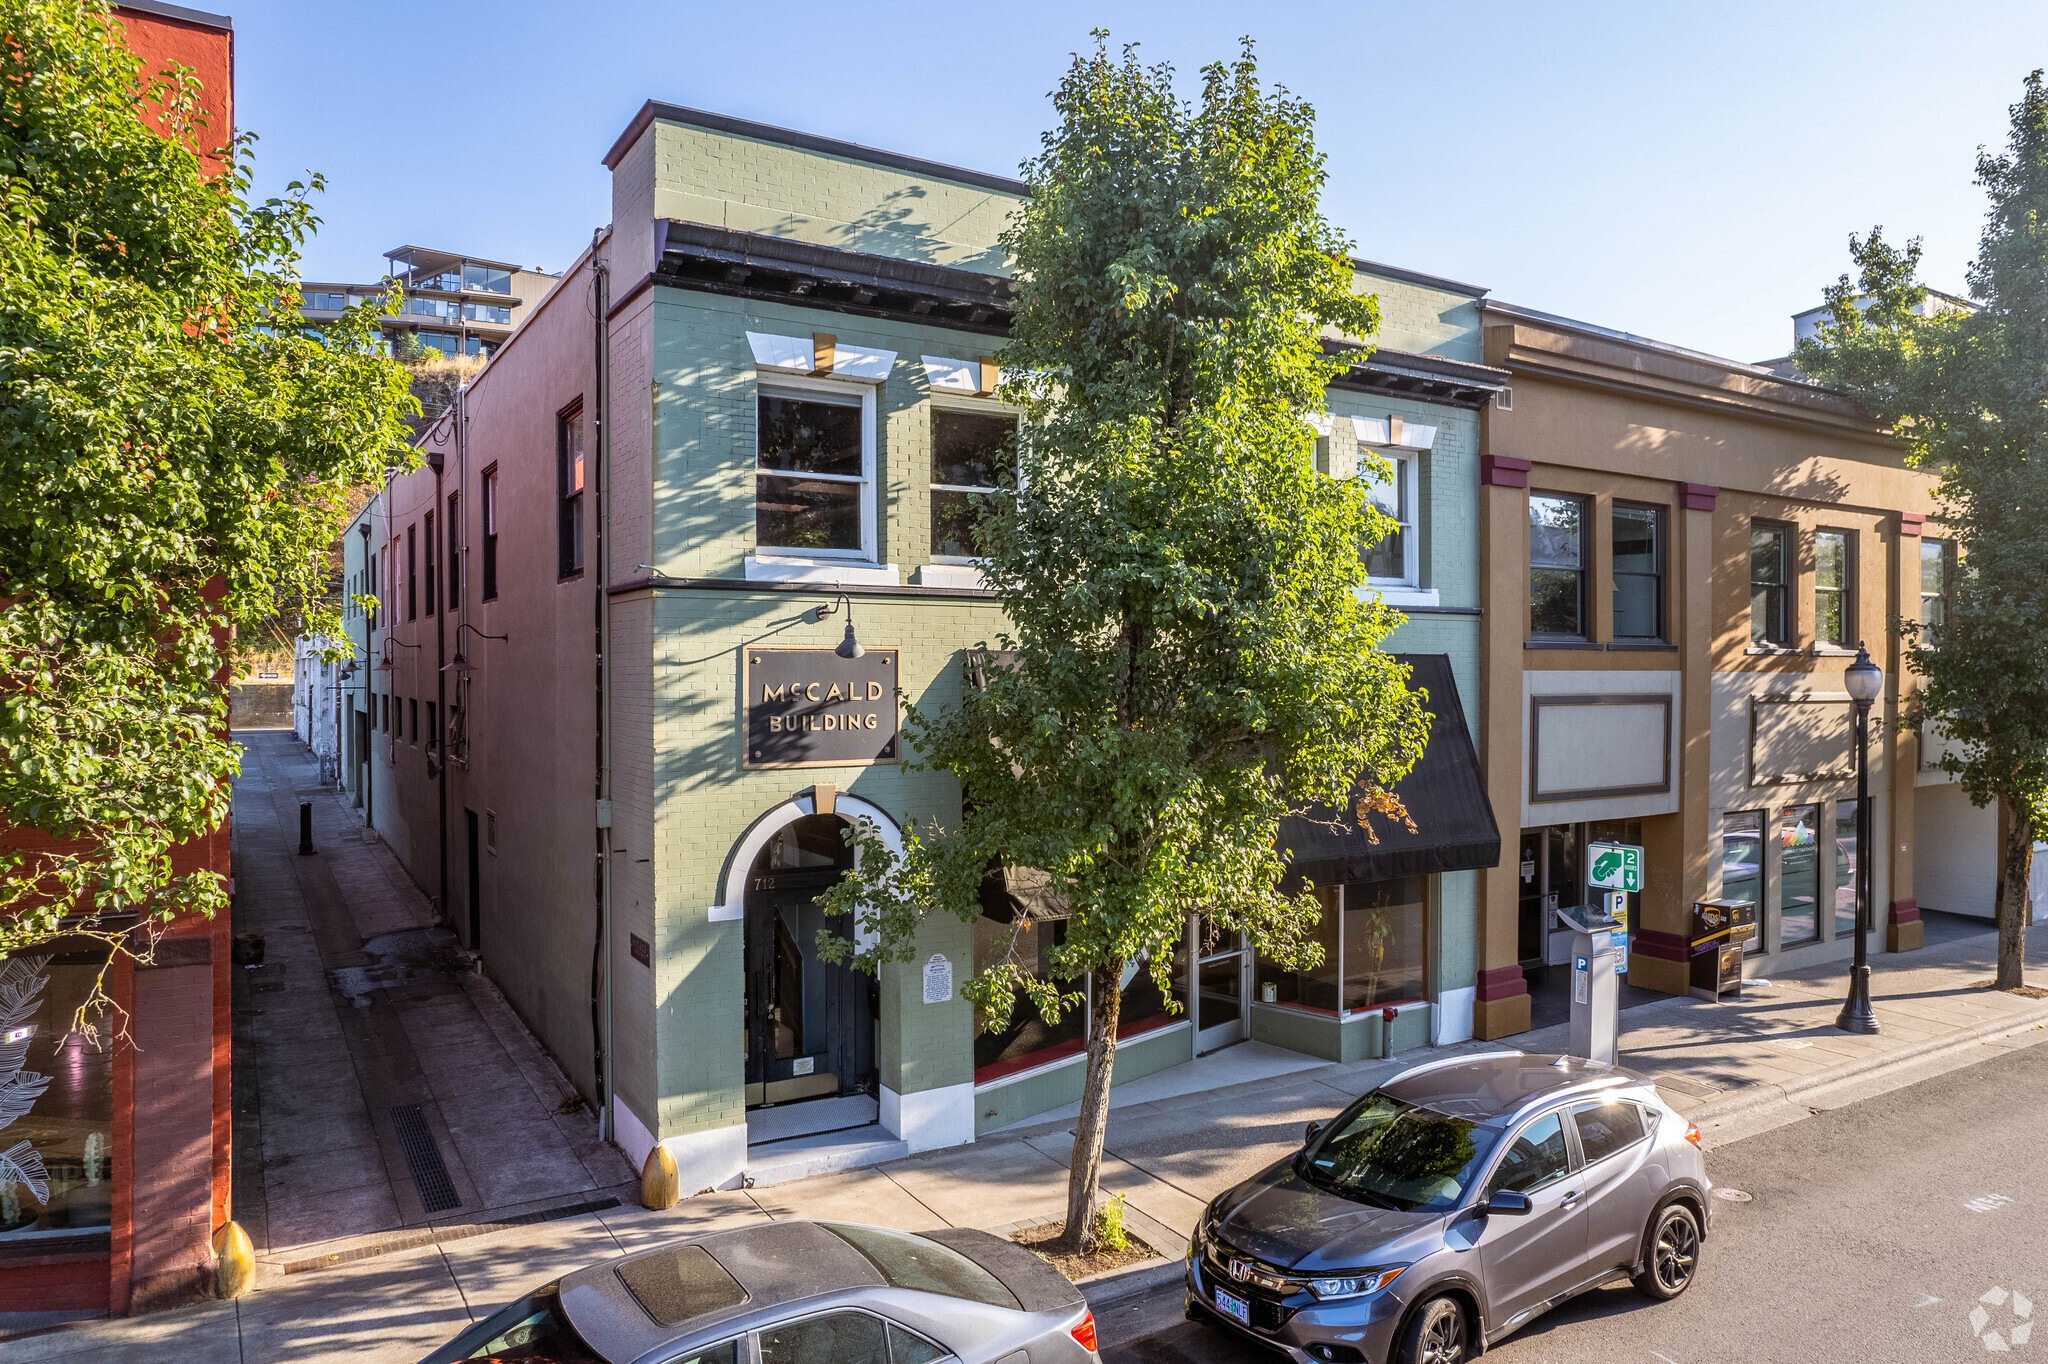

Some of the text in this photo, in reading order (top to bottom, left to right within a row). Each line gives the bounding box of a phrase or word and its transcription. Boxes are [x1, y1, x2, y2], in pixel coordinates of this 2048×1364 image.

[769, 714, 878, 733] BUILDING
[1627, 853, 1635, 864] 2
[755, 878, 775, 890] 712
[1615, 896, 1623, 909] P
[1578, 958, 1586, 969] P
